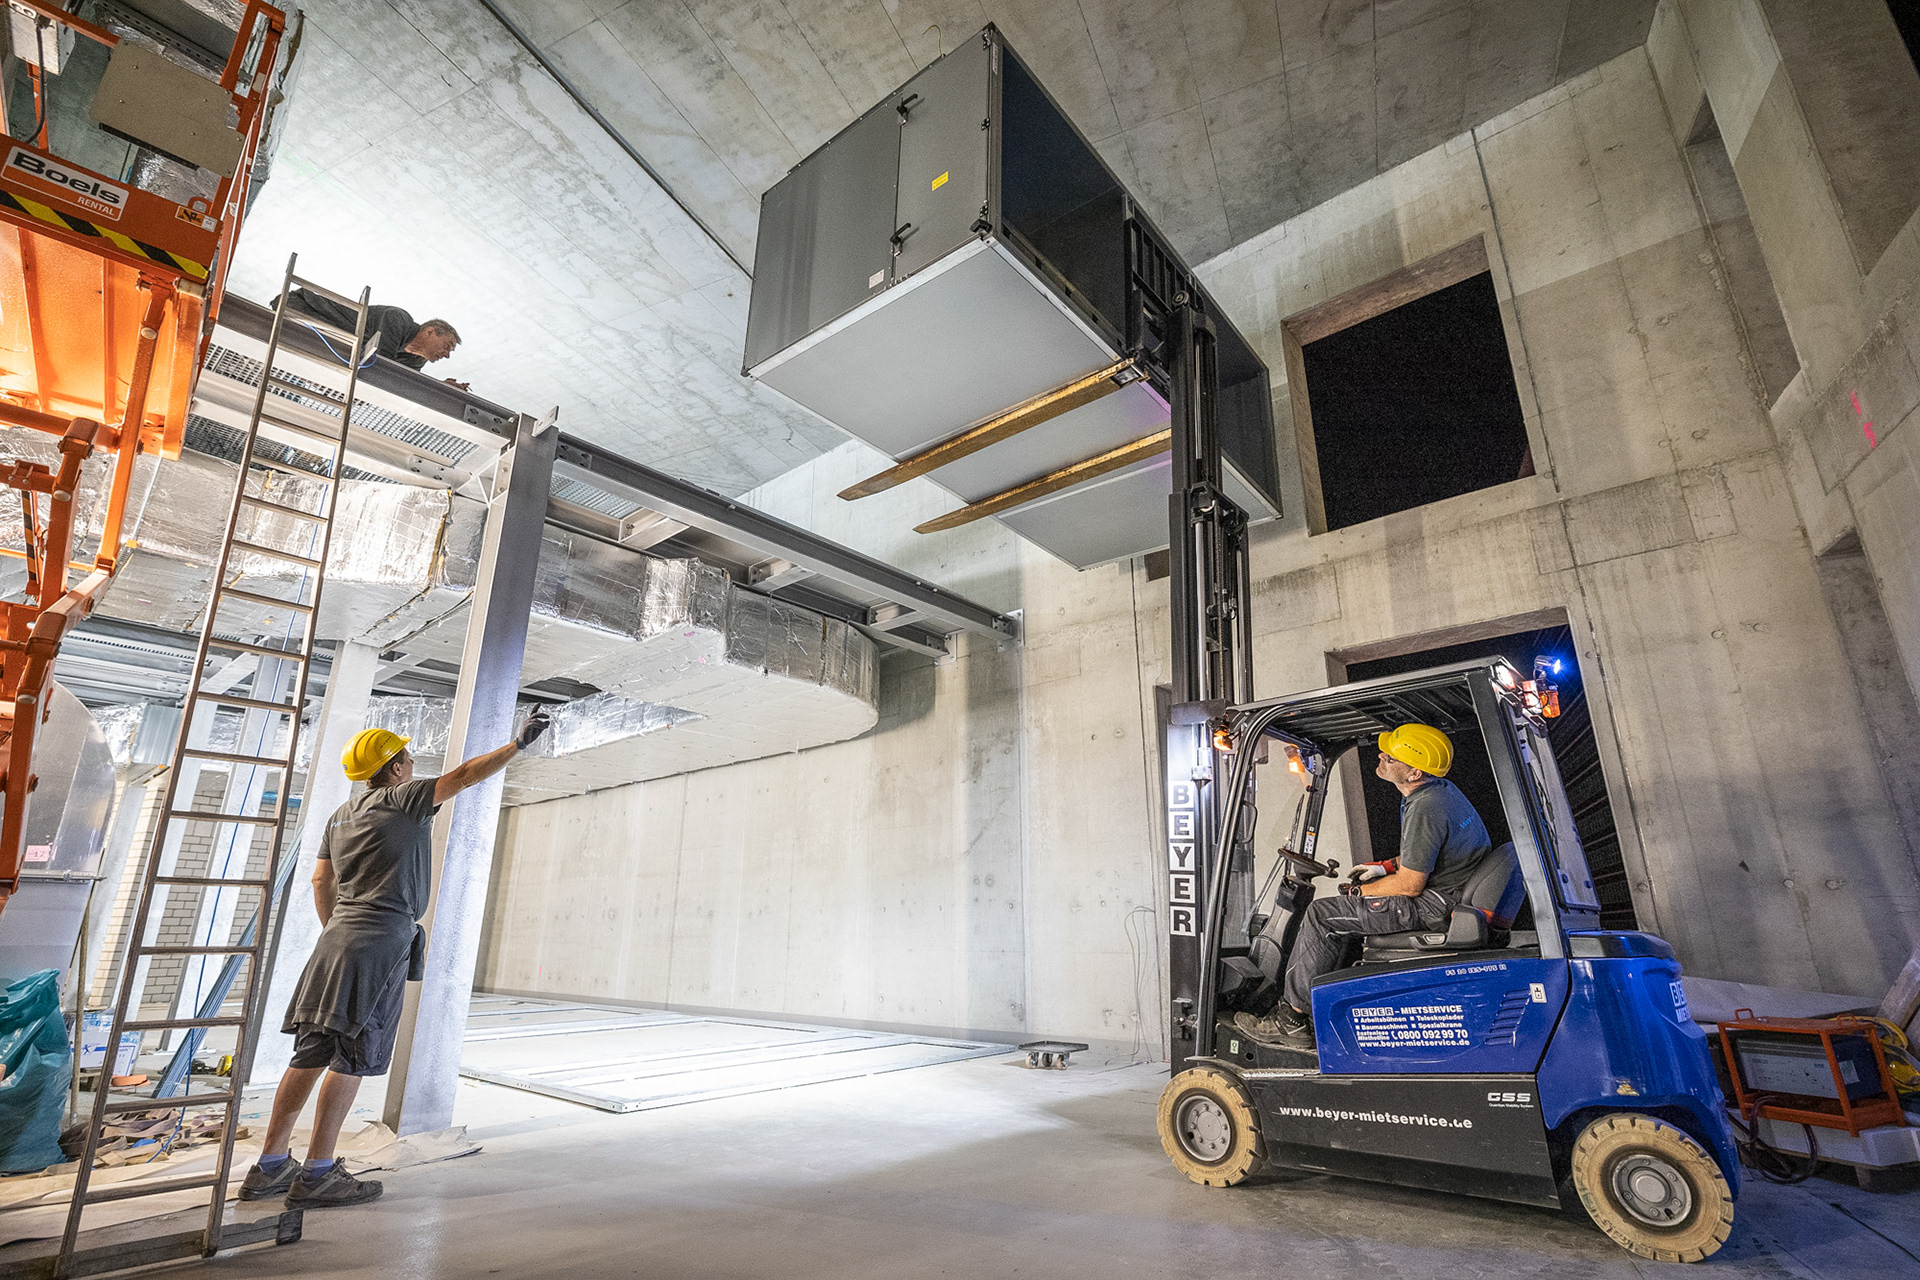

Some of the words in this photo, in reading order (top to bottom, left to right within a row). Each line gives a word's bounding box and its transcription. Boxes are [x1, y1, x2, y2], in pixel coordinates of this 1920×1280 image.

[13, 152, 120, 204] Boels
[77, 196, 115, 216] RENTAL
[1172, 784, 1192, 933] BEYER
[1353, 1008, 1394, 1017] BEYER
[1400, 1005, 1463, 1015] MIETSERVICE
[1397, 1030, 1421, 1040] 0800
[1422, 1029, 1441, 1039] 092
[1441, 1029, 1454, 1039] 99
[1455, 1029, 1468, 1038] 70
[1359, 1039, 1470, 1048] www.beyer-mietservice.de
[1488, 1092, 1531, 1102] GSS
